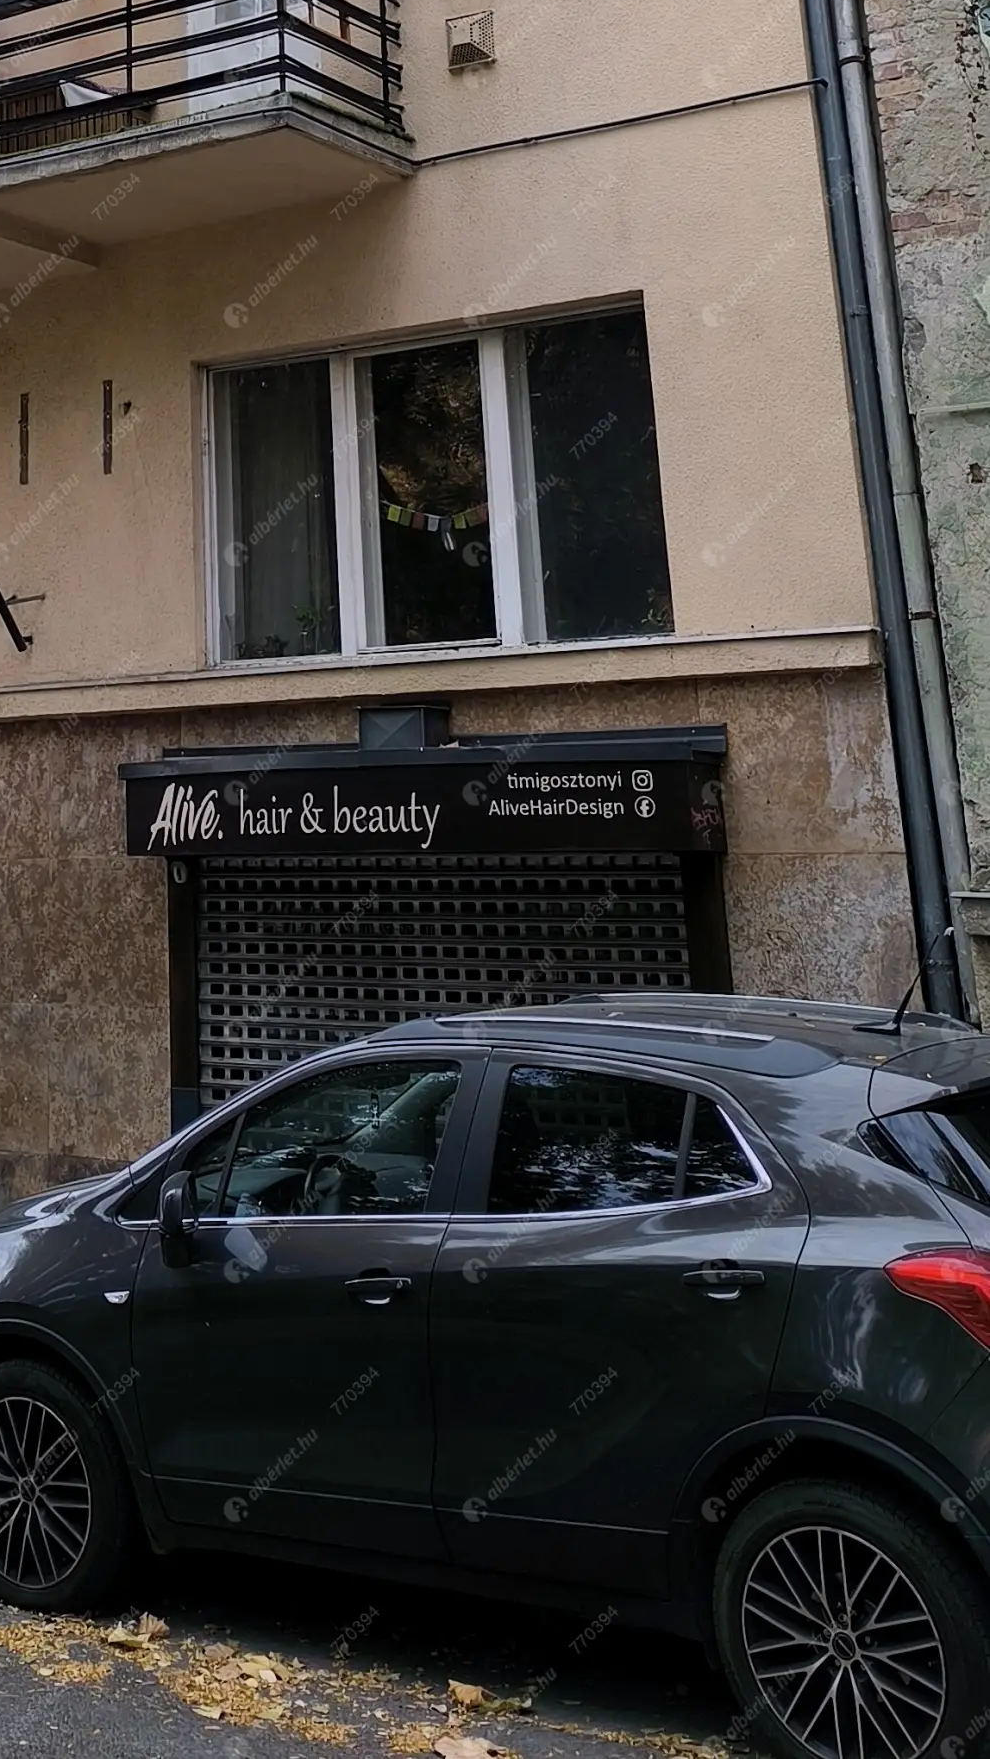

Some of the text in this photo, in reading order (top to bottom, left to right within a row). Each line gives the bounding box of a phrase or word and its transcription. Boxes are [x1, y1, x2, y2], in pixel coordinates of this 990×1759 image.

[507, 771, 623, 791] timigosztonyi
[147, 782, 441, 851] Alive. hair & beauty
[488, 798, 625, 819] AliveHairDesign
